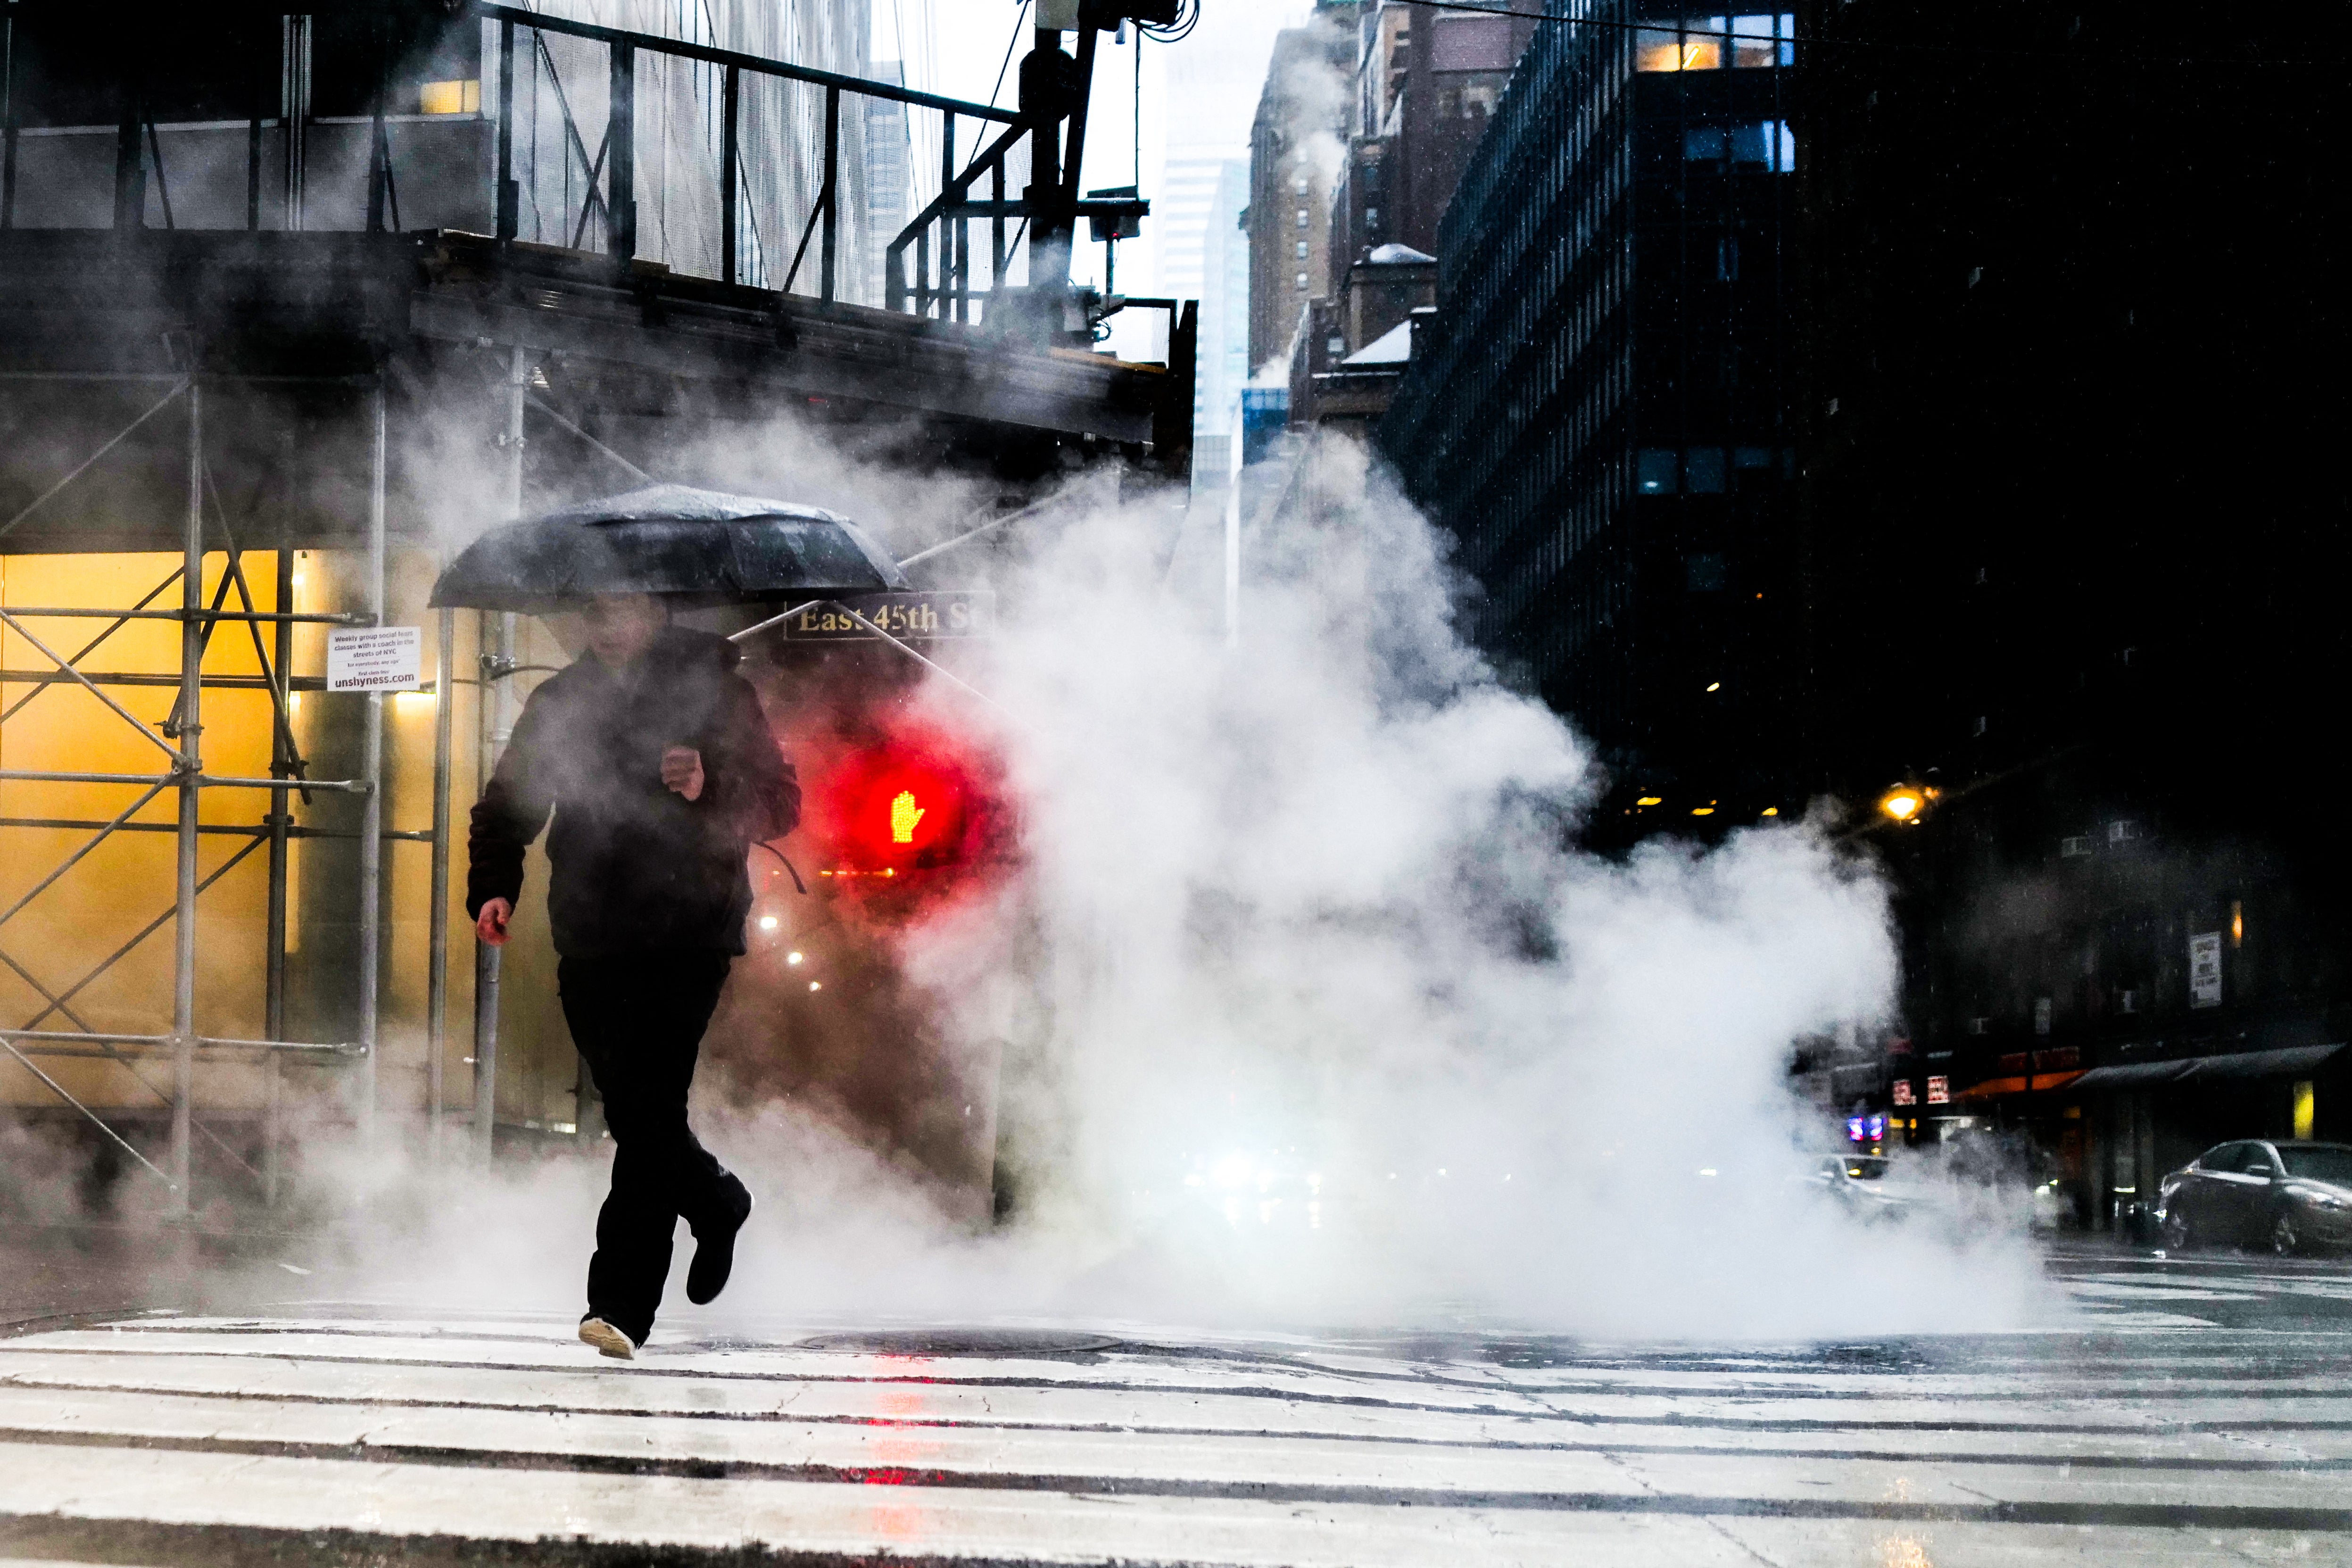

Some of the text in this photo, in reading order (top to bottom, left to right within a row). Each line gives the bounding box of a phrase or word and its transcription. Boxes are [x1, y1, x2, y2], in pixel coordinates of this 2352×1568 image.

[799, 607, 864, 631] East
[873, 603, 939, 630] 45th
[335, 673, 414, 688] unshyness.com
